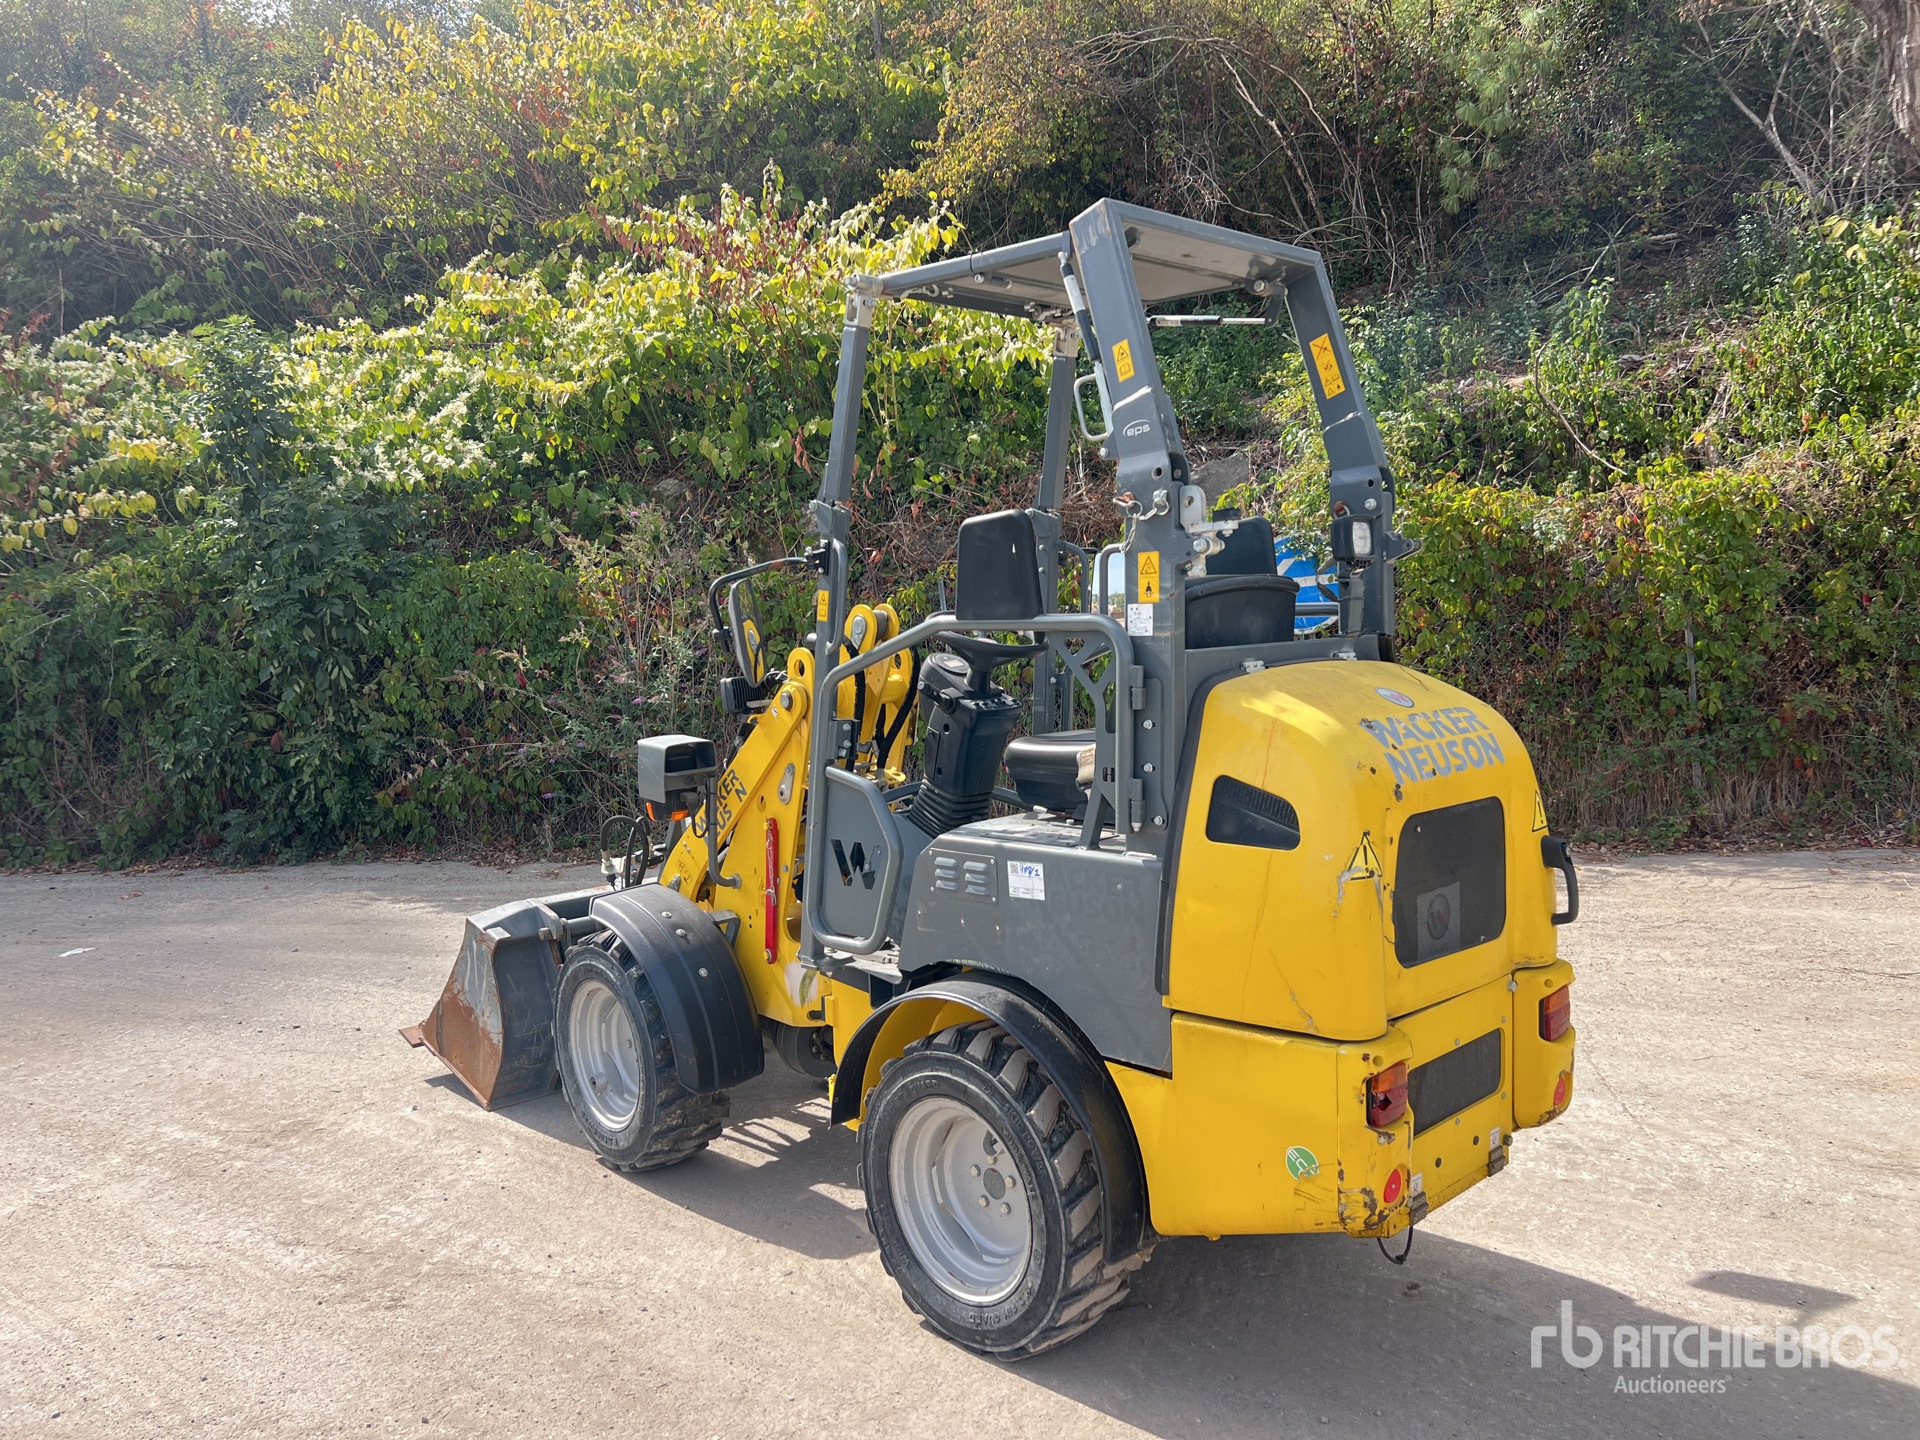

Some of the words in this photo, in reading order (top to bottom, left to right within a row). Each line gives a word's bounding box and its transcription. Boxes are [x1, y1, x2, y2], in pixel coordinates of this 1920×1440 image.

[1126, 424, 1151, 437] eps
[1358, 706, 1490, 749] WACKER
[1384, 733, 1506, 785] NEUSON
